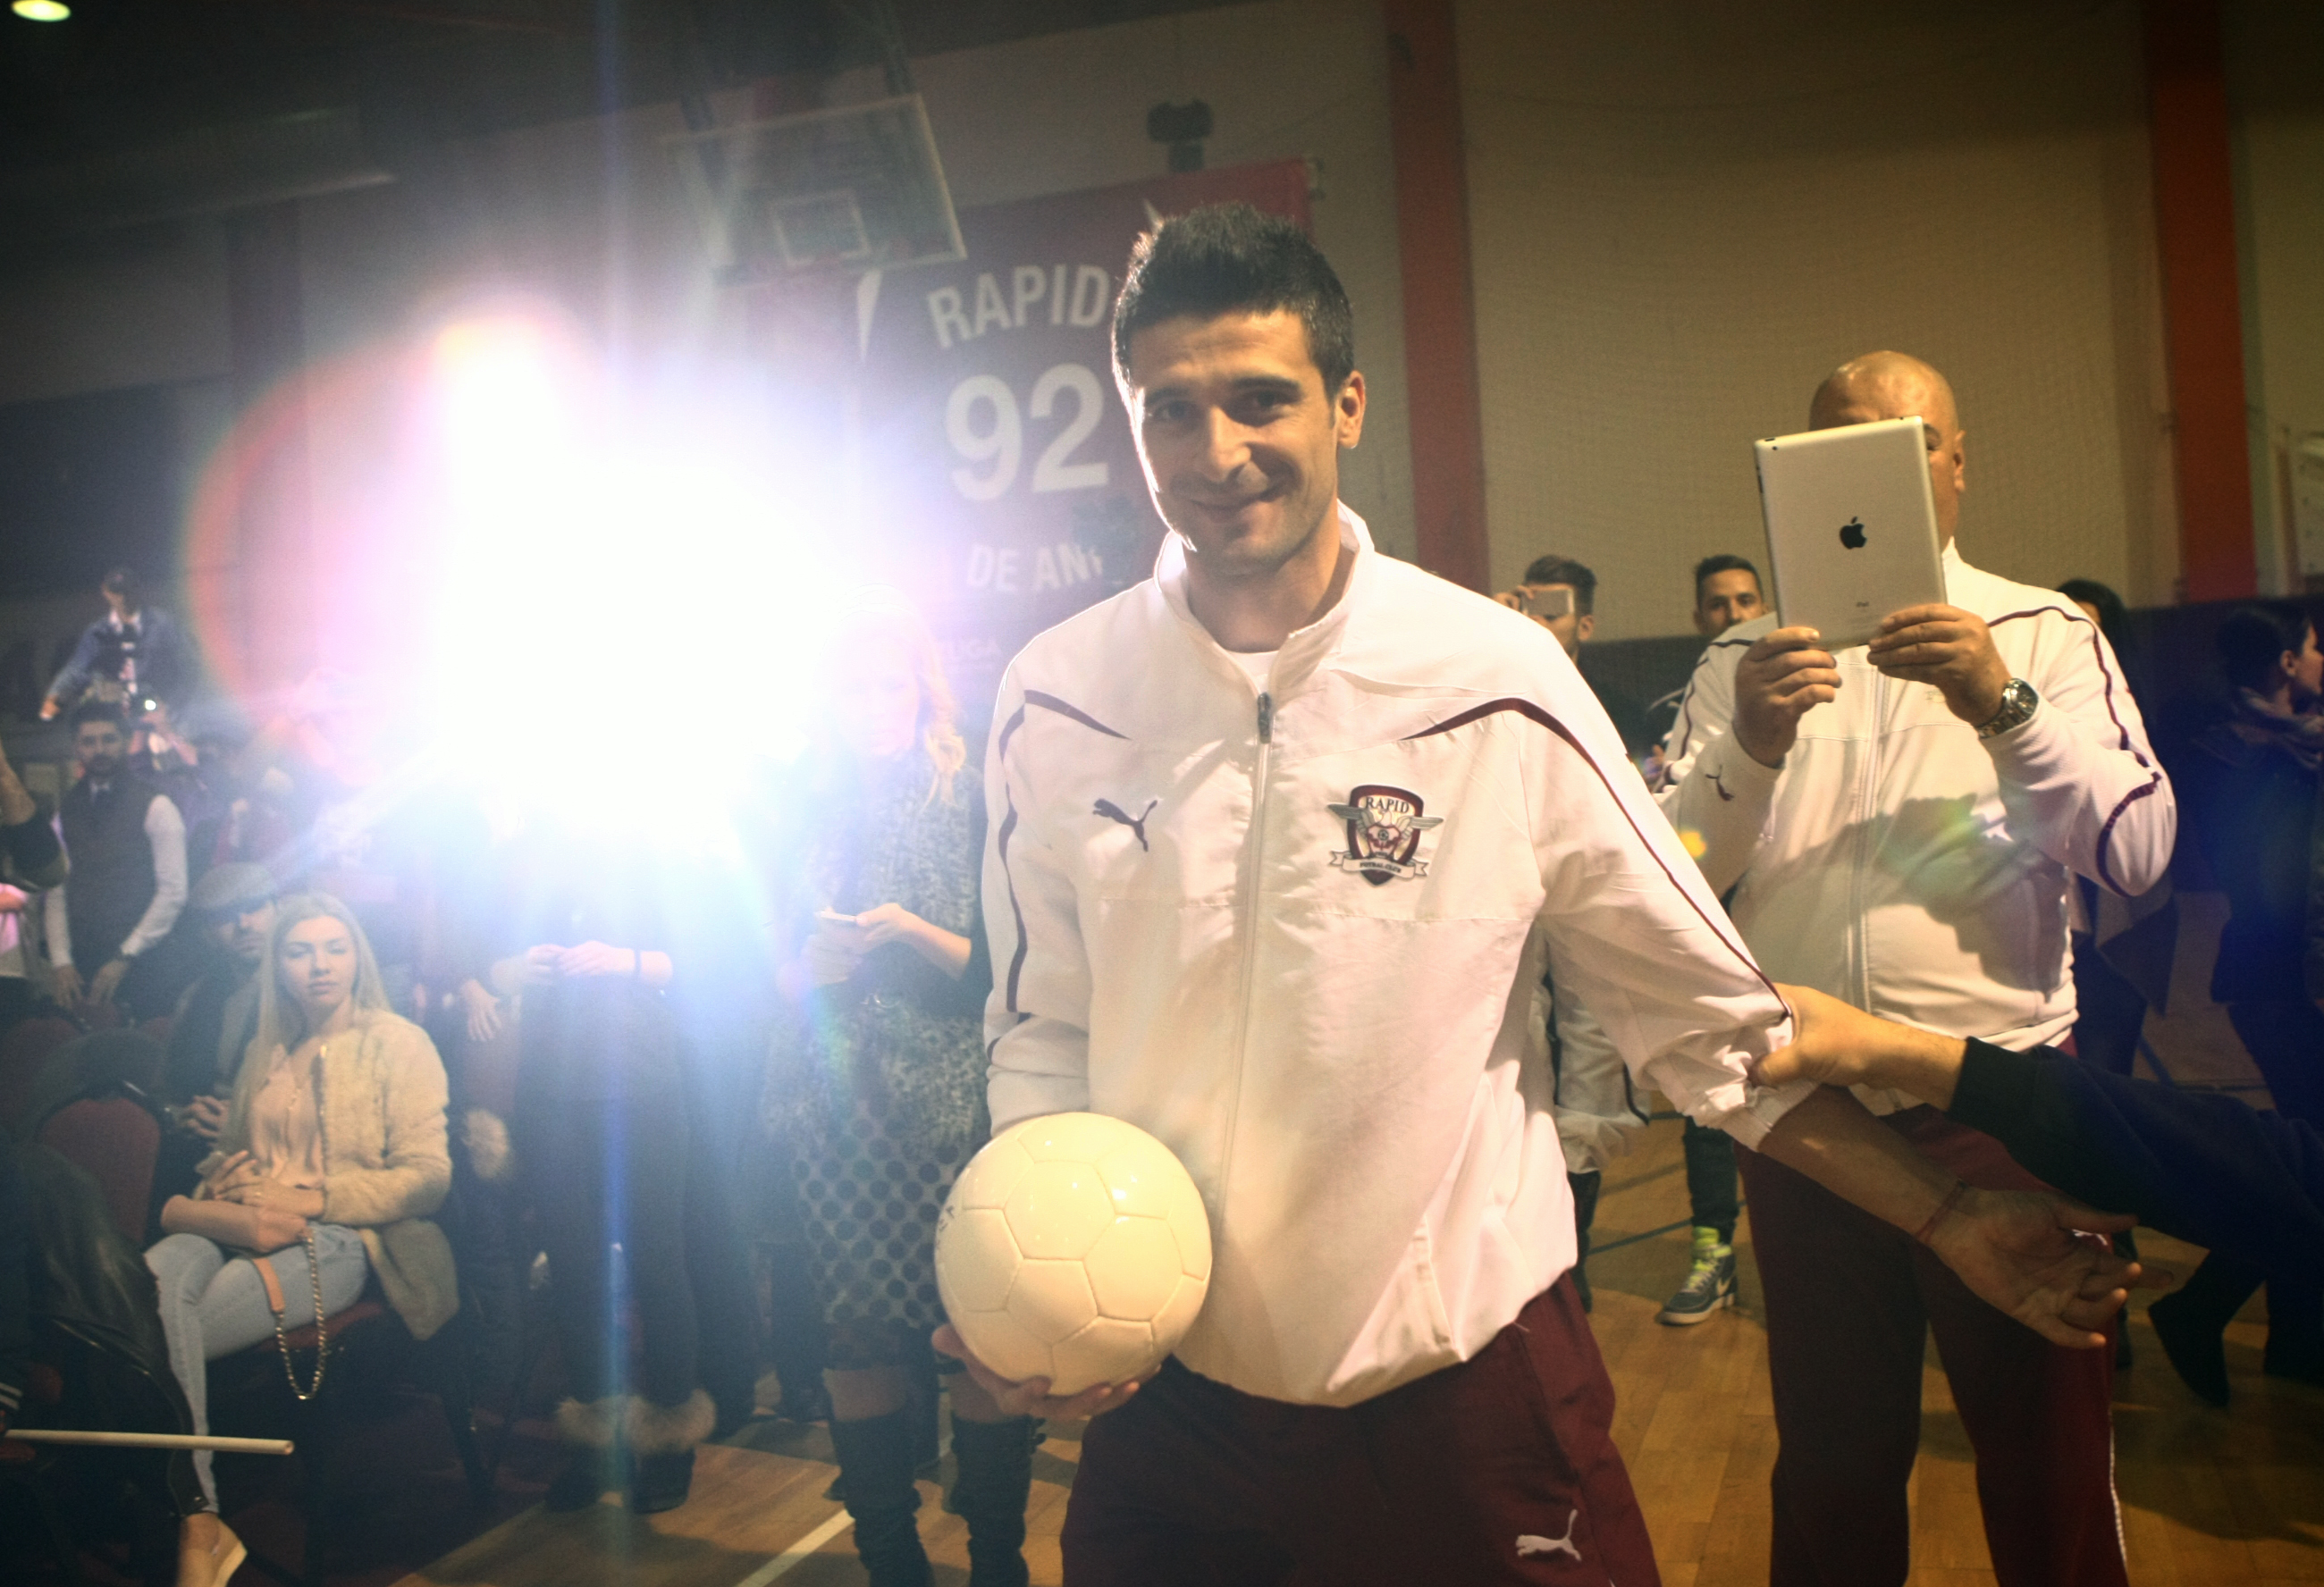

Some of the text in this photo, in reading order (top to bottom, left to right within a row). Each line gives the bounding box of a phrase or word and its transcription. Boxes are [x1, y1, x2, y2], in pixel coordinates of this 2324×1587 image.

[926, 264, 1110, 348] RAPID
[945, 363, 1109, 502] 92
[966, 544, 1021, 593] DE
[1366, 797, 1410, 813] RAPID
